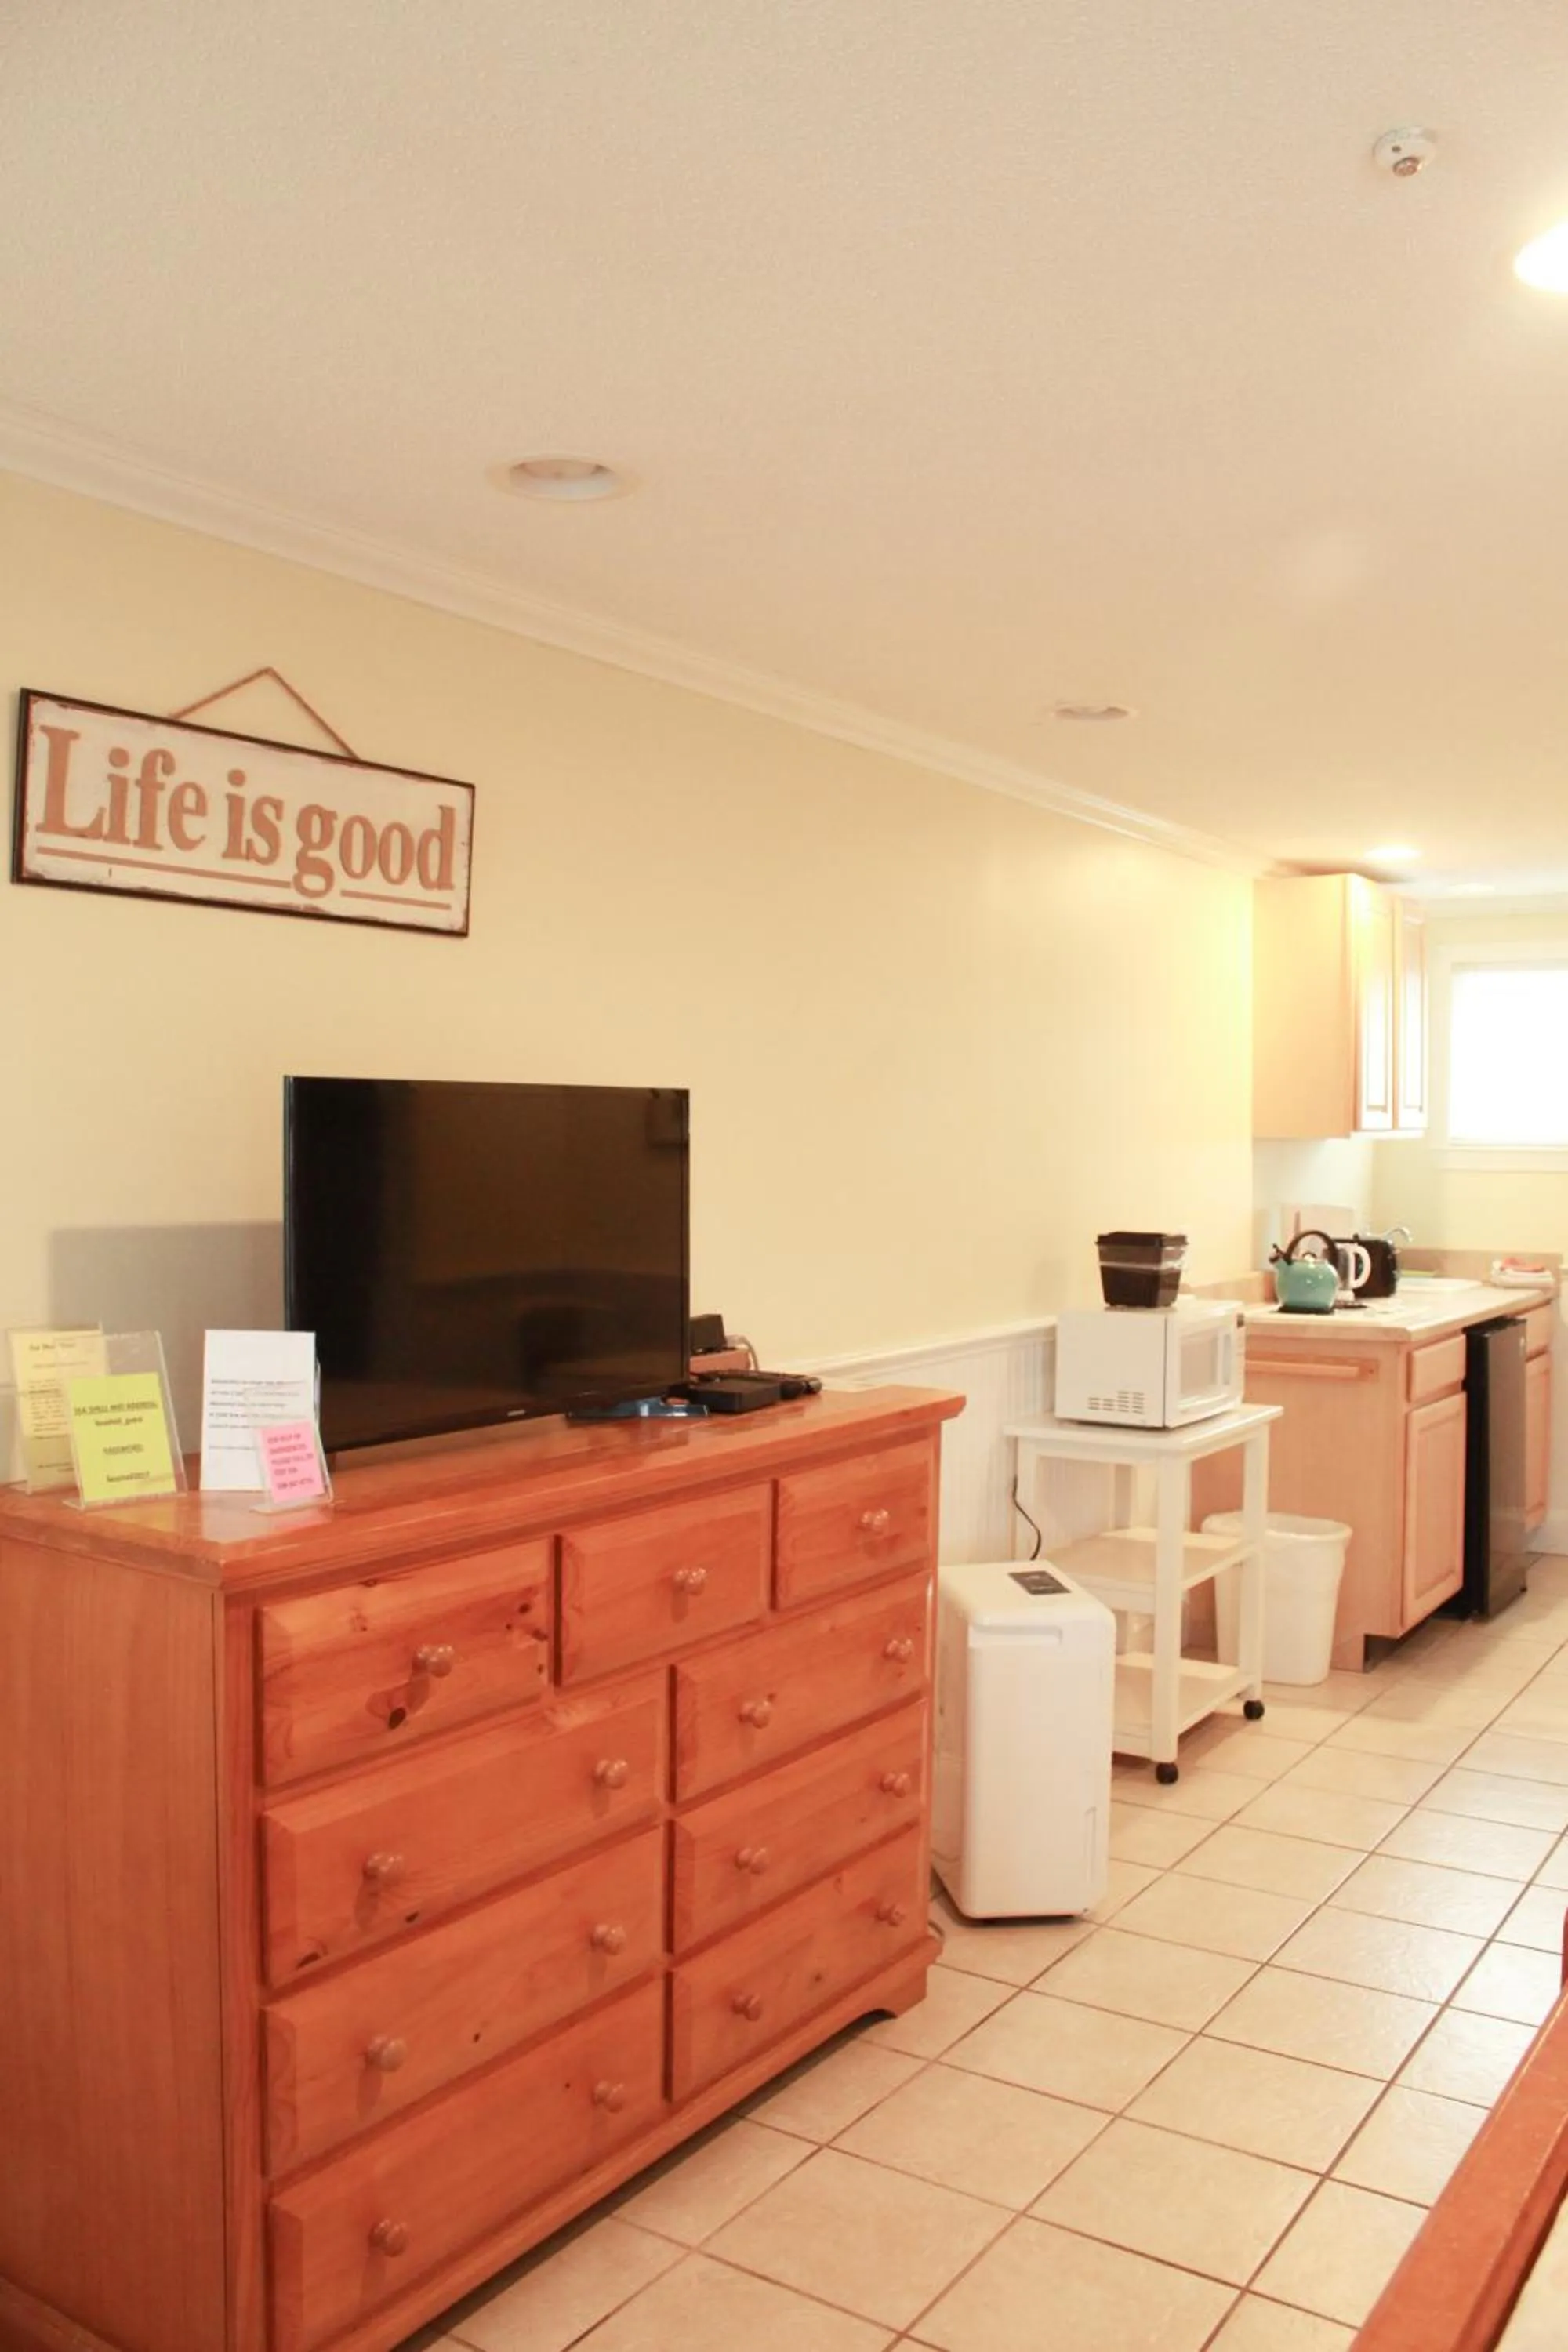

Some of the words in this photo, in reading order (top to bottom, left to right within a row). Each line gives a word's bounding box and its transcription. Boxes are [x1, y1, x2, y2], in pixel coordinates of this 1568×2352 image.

[36, 725, 207, 851] Life
[222, 769, 283, 866] is
[292, 804, 455, 899] good
